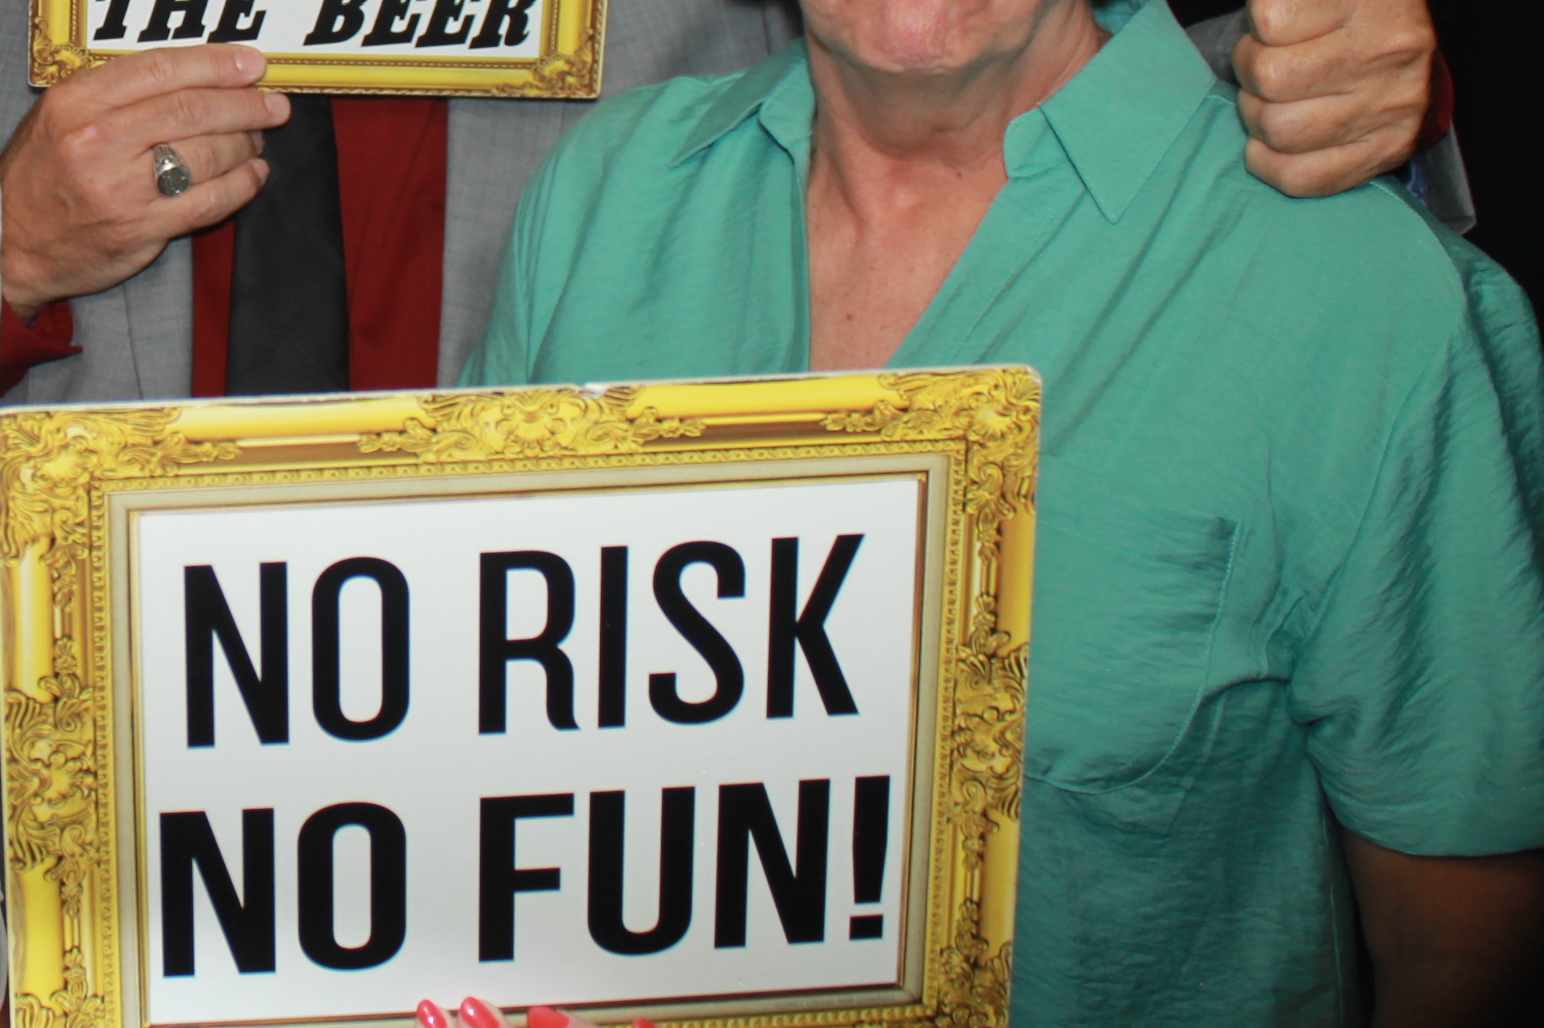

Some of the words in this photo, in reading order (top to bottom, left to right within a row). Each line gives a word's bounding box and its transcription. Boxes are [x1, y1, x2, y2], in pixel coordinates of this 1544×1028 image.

[185, 557, 409, 747] NO
[479, 534, 863, 734] RISK
[160, 802, 406, 976] NO
[479, 775, 890, 962] FUN!
